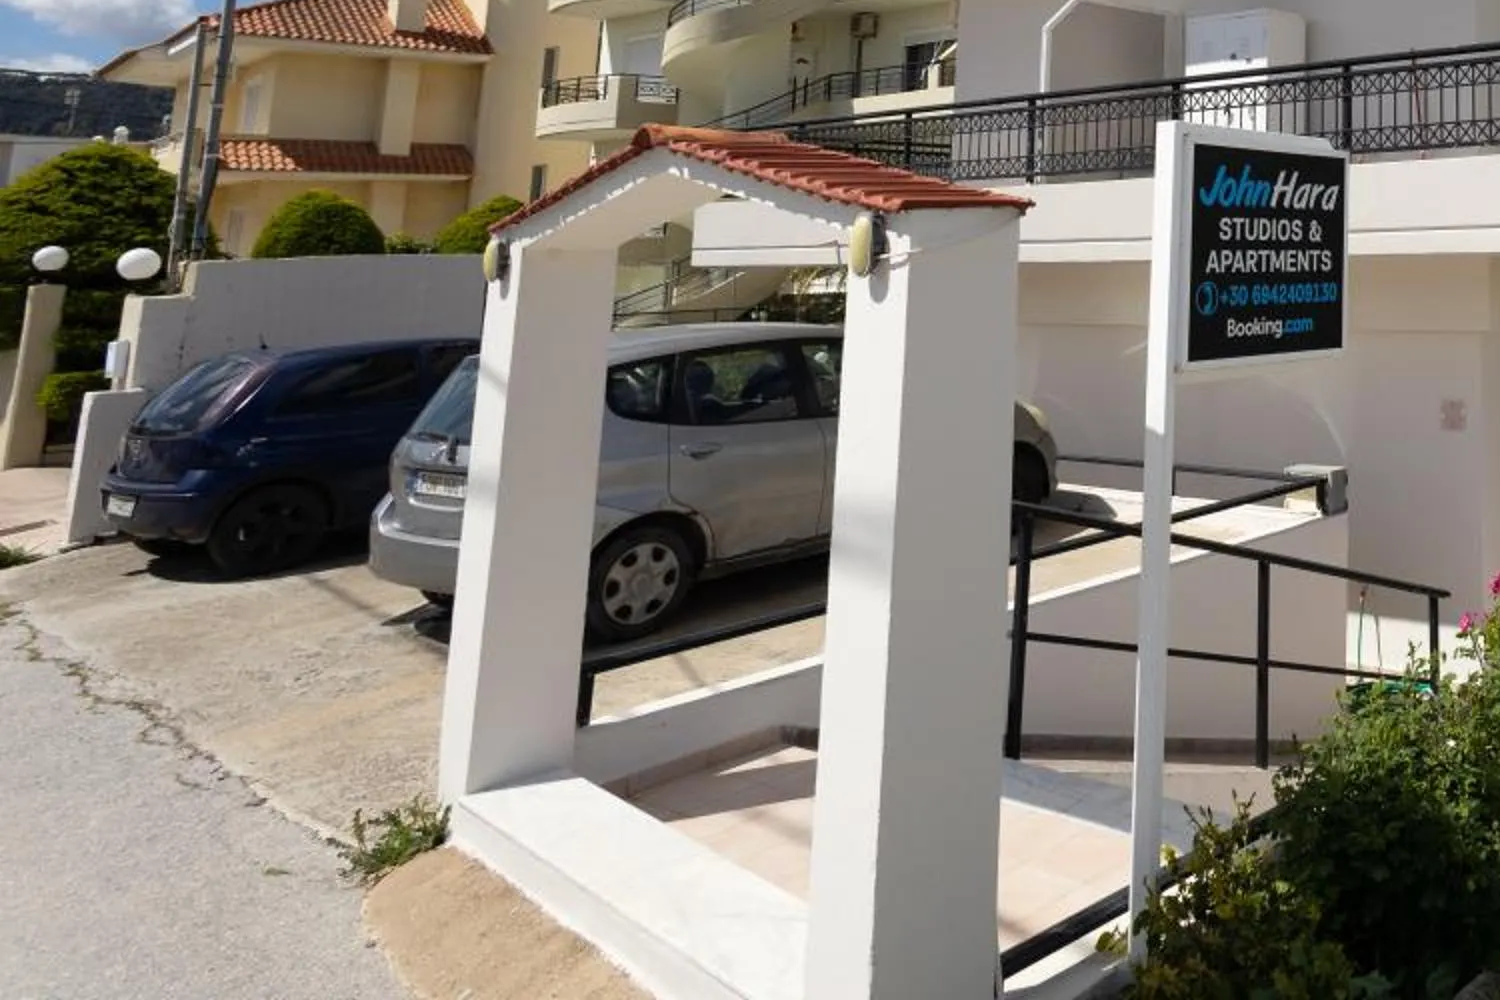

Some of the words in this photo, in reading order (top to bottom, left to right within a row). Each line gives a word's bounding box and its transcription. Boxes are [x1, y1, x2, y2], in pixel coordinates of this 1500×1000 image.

[1199, 164, 1340, 212] JohnHara
[1219, 217, 1303, 242] STUDIOS
[1309, 220, 1322, 242] &
[1205, 250, 1332, 273] APARTMENTS
[1219, 284, 1248, 306] +30
[1227, 316, 1313, 338] Booking.com
